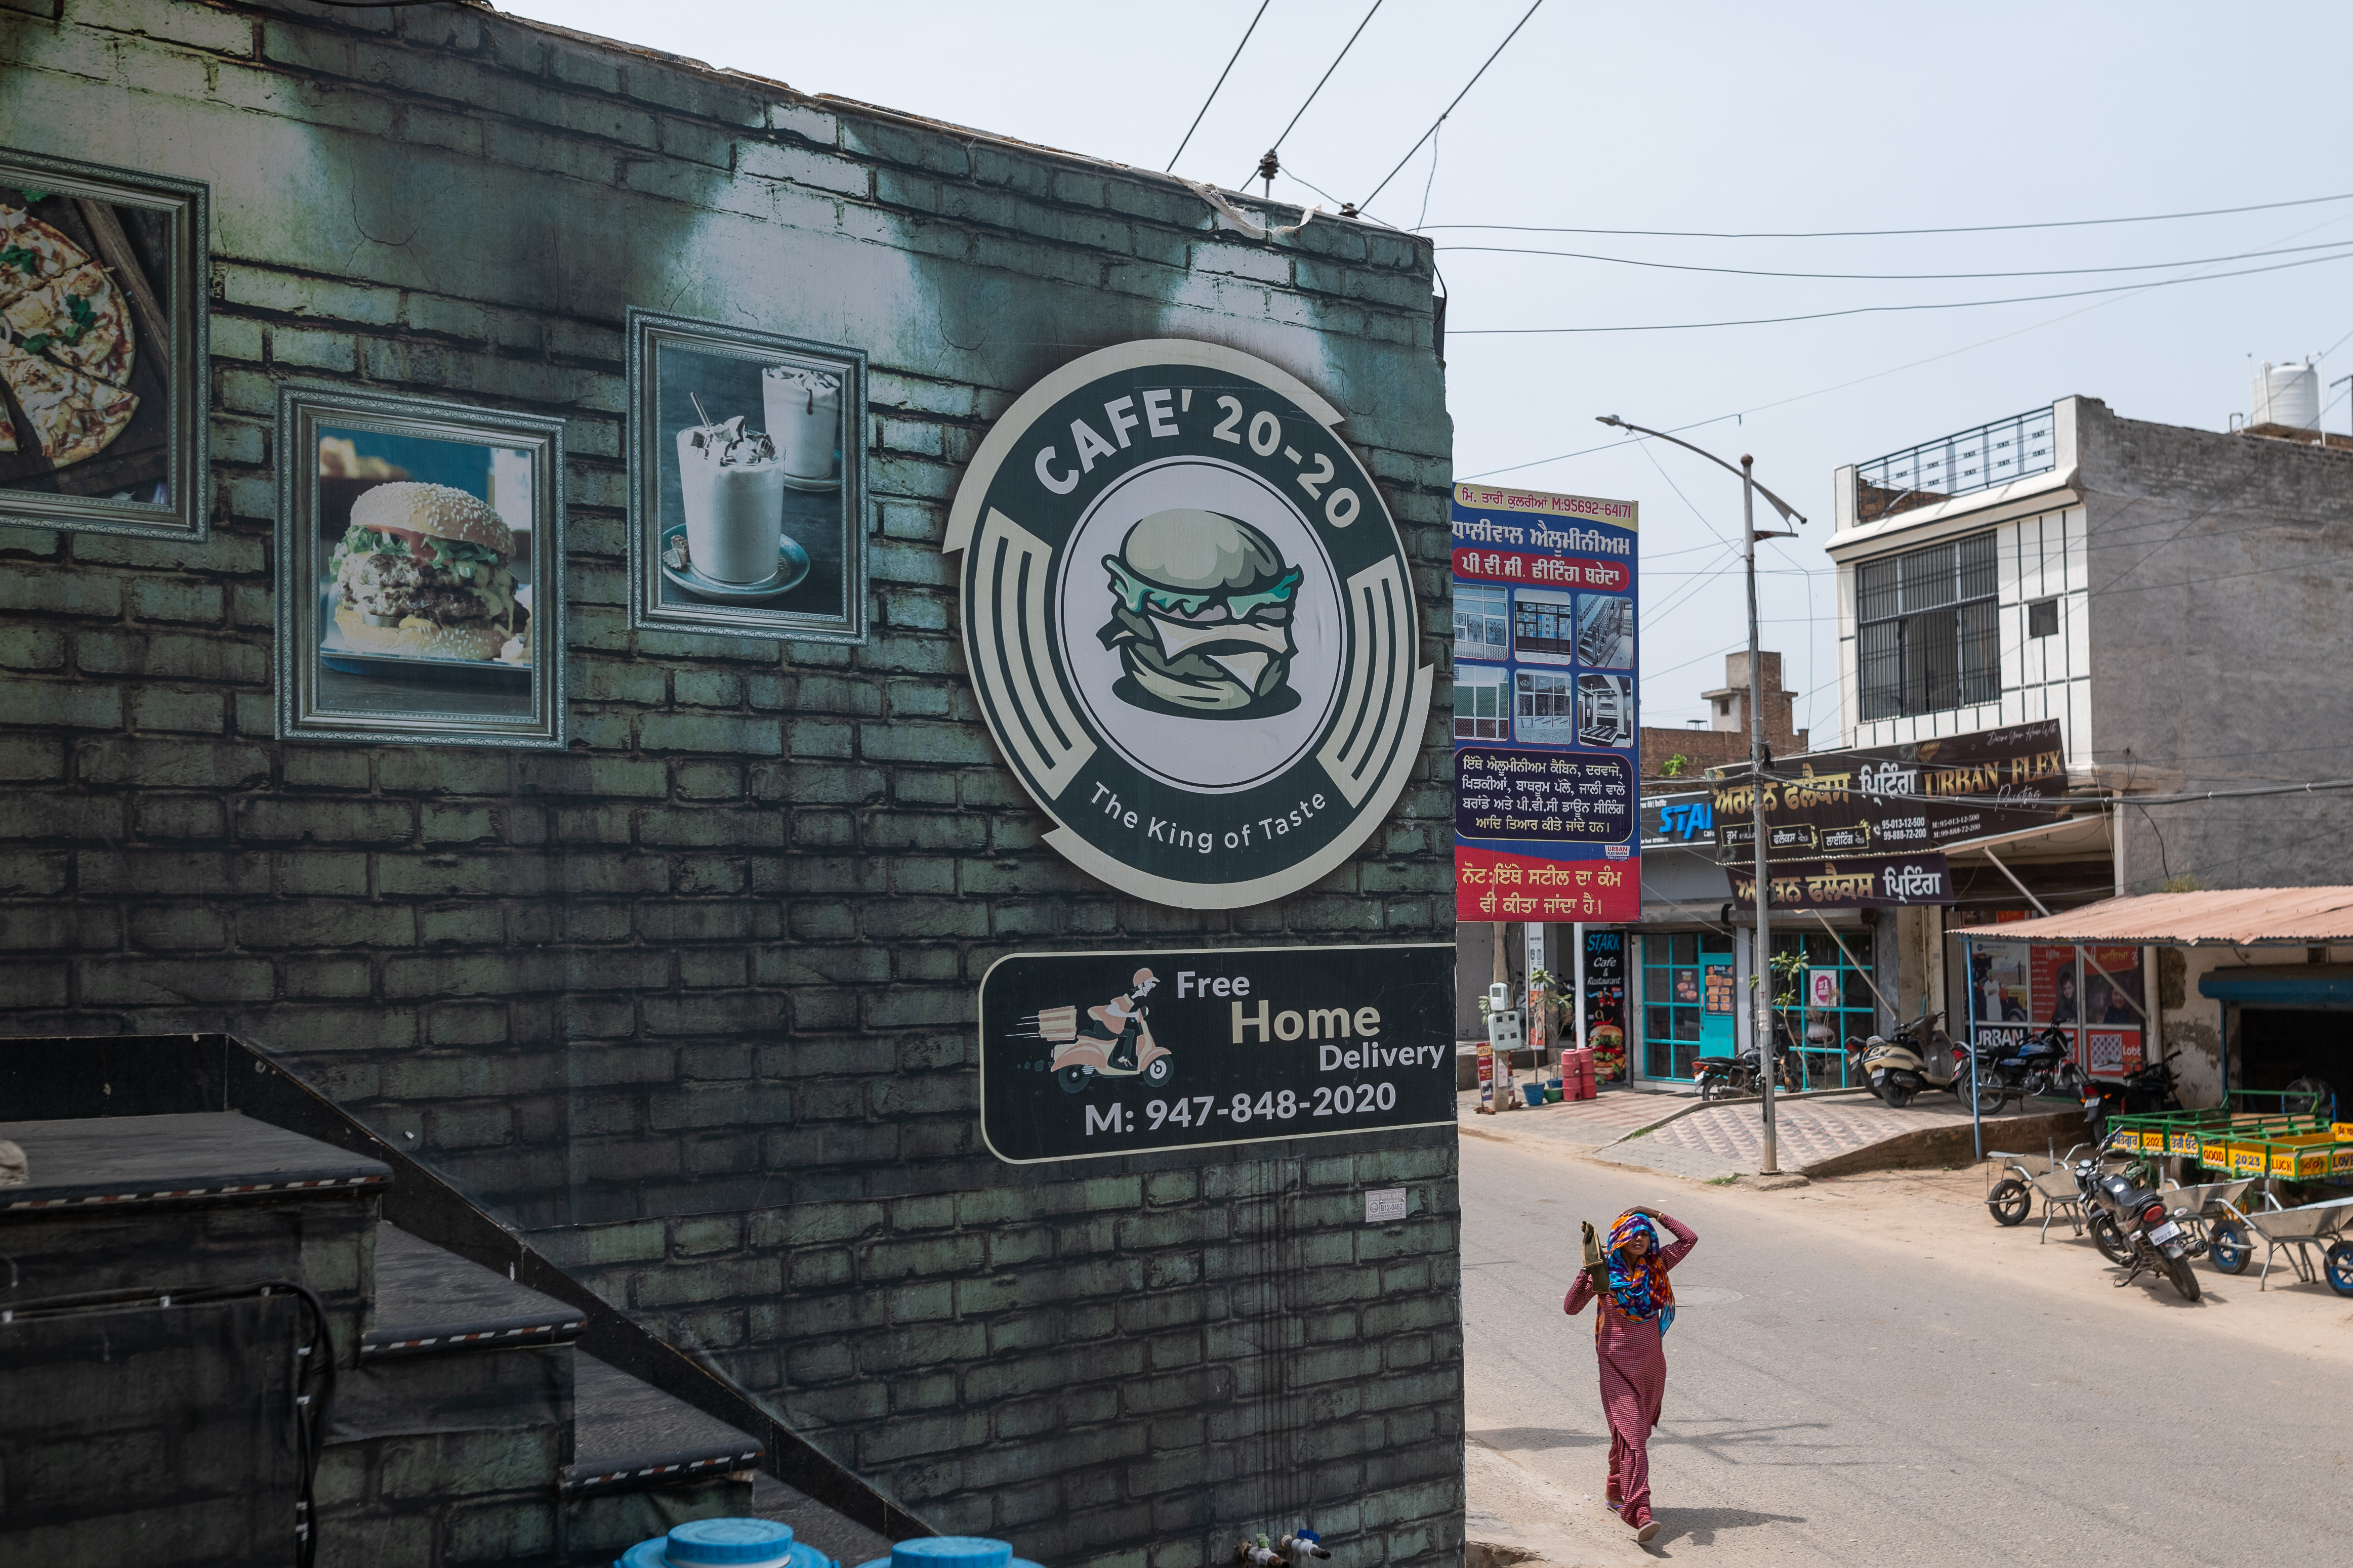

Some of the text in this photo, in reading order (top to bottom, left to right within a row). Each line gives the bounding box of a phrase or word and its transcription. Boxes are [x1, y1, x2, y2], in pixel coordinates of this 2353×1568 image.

[1035, 389, 1361, 528] CAFE' 20-20
[1584, 562, 1620, 585] ਬਰੇਟਾ
[1924, 750, 2061, 799] URBAN FLEX
[1494, 795, 1513, 811] ਅਤੇ
[1091, 781, 1326, 854] The King of Taste
[1882, 817, 1925, 829] 95-013-12-500
[1883, 828, 1926, 840] 99-888-72-200
[1528, 864, 1570, 885] ਸਟੀਲ
[1575, 870, 1593, 886] ਦਾ
[1598, 865, 1622, 887] ਕੰਮ
[1736, 876, 1801, 903] ਅਬਨ
[1480, 891, 1497, 913] ਵੀ
[1503, 892, 1538, 913] ਕੀਤਾ
[1587, 934, 1621, 955] STARK
[1594, 957, 1616, 966] Cafe
[1603, 968, 1608, 977] &
[1177, 970, 1250, 998] Free
[1587, 977, 1621, 985] Restaurant
[1231, 1000, 1380, 1044] Home
[1319, 1041, 1446, 1072] Delivery
[1085, 1082, 1397, 1136] M: 947-848-2020
[2204, 1150, 2292, 1171] GOOD 2023 LUCK
[1380, 1203, 1402, 1211] B12-0482
